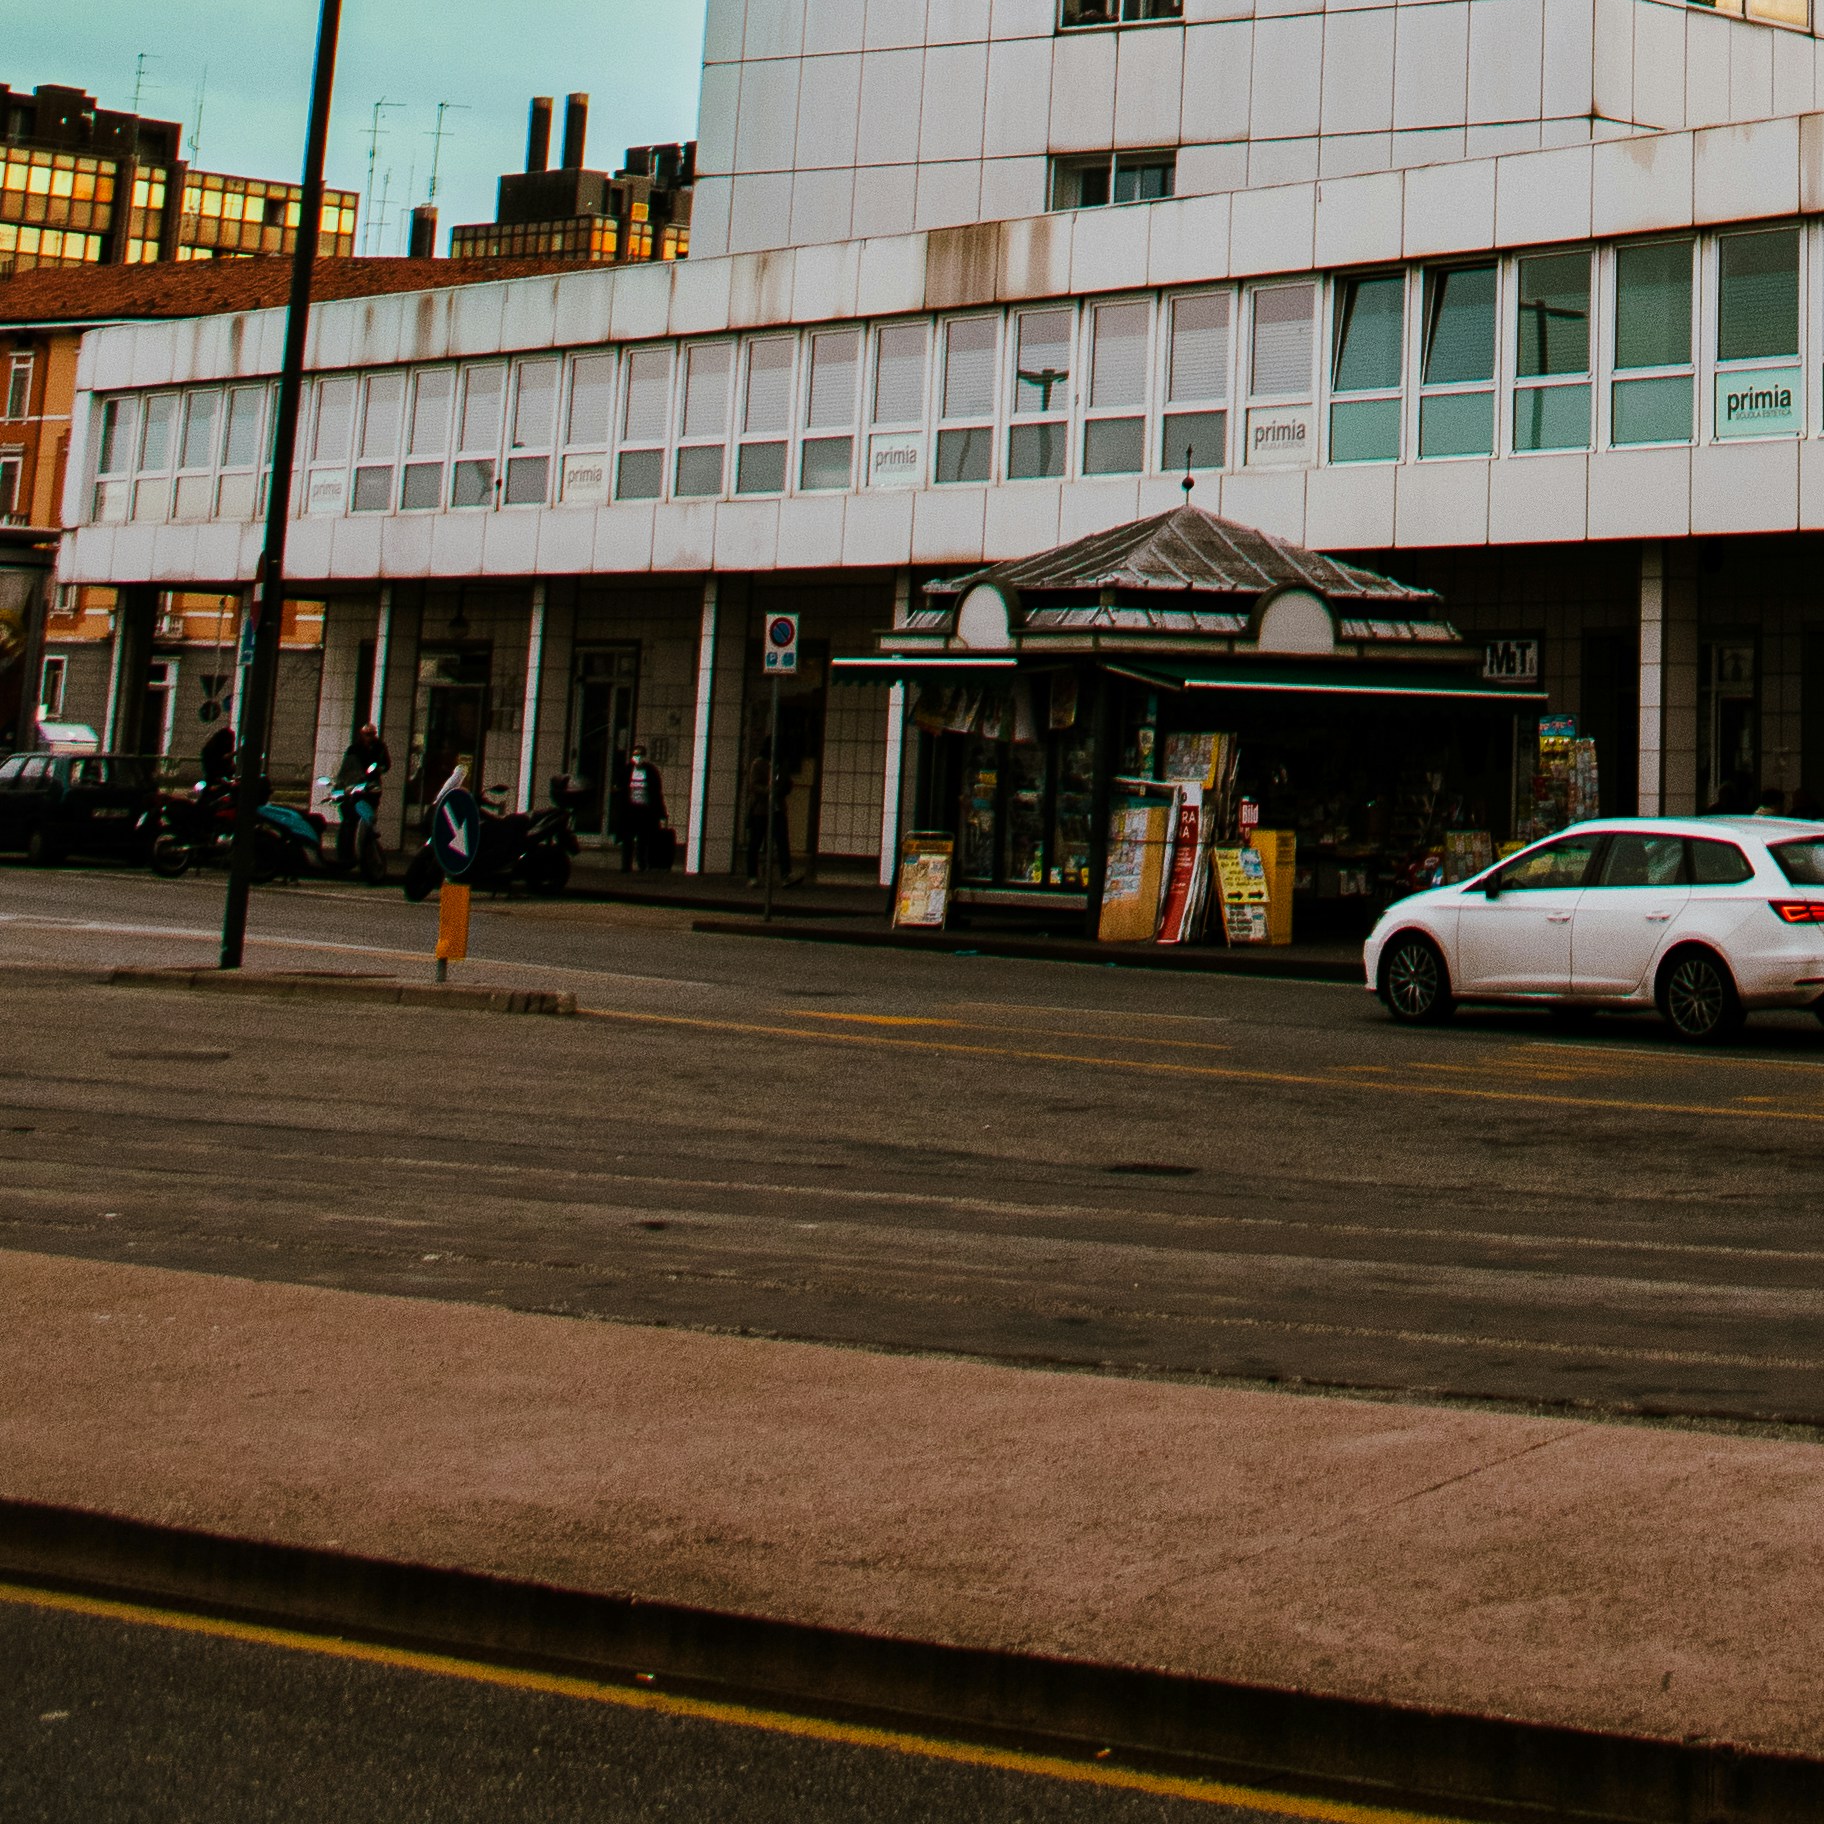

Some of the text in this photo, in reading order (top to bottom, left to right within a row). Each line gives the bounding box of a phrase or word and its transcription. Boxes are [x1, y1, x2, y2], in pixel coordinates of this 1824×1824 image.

[1727, 384, 1792, 421] primia
[1254, 418, 1306, 450] primia
[875, 444, 917, 473] primia
[569, 463, 603, 488] primia
